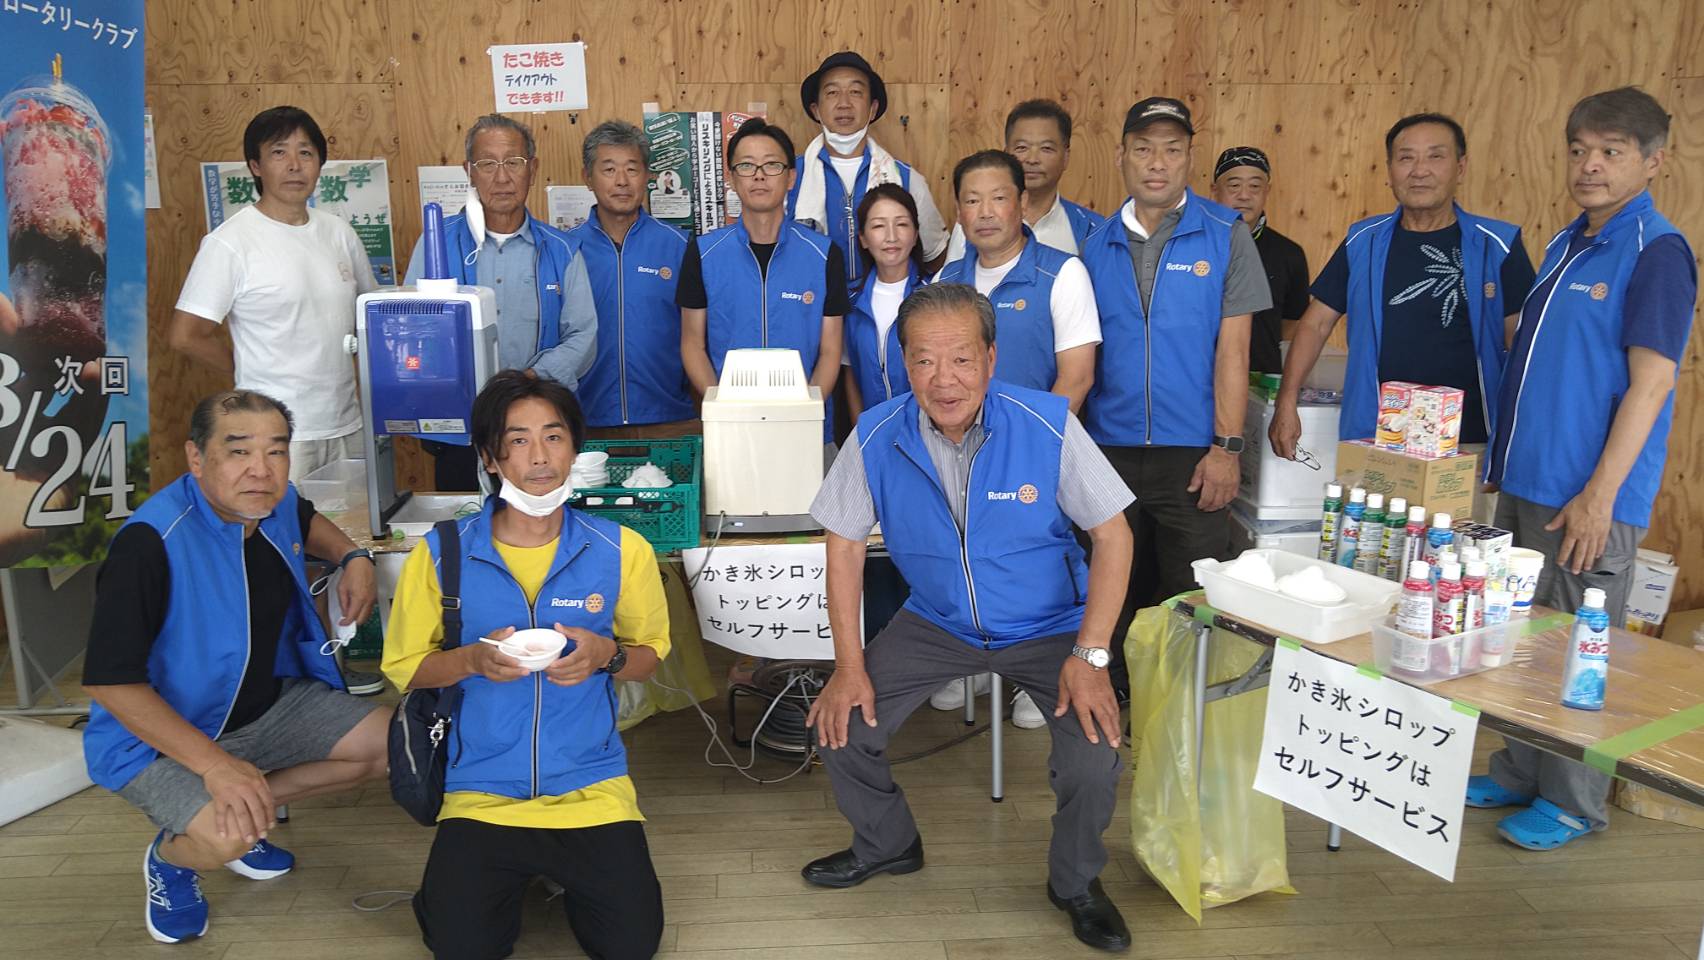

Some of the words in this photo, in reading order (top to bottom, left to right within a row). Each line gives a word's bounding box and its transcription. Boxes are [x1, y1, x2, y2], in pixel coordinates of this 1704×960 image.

[503, 51, 565, 68] たこ焼き
[505, 73, 557, 87] テイクアウト
[1166, 263, 1192, 273] Rotary
[54, 355, 130, 396] 次回
[988, 491, 1017, 501] Rotary
[551, 597, 584, 609] Rotary
[1288, 671, 1456, 747] かき氷シロップ
[1298, 714, 1432, 787] トッピングは
[1274, 746, 1449, 843] セルフサービス
